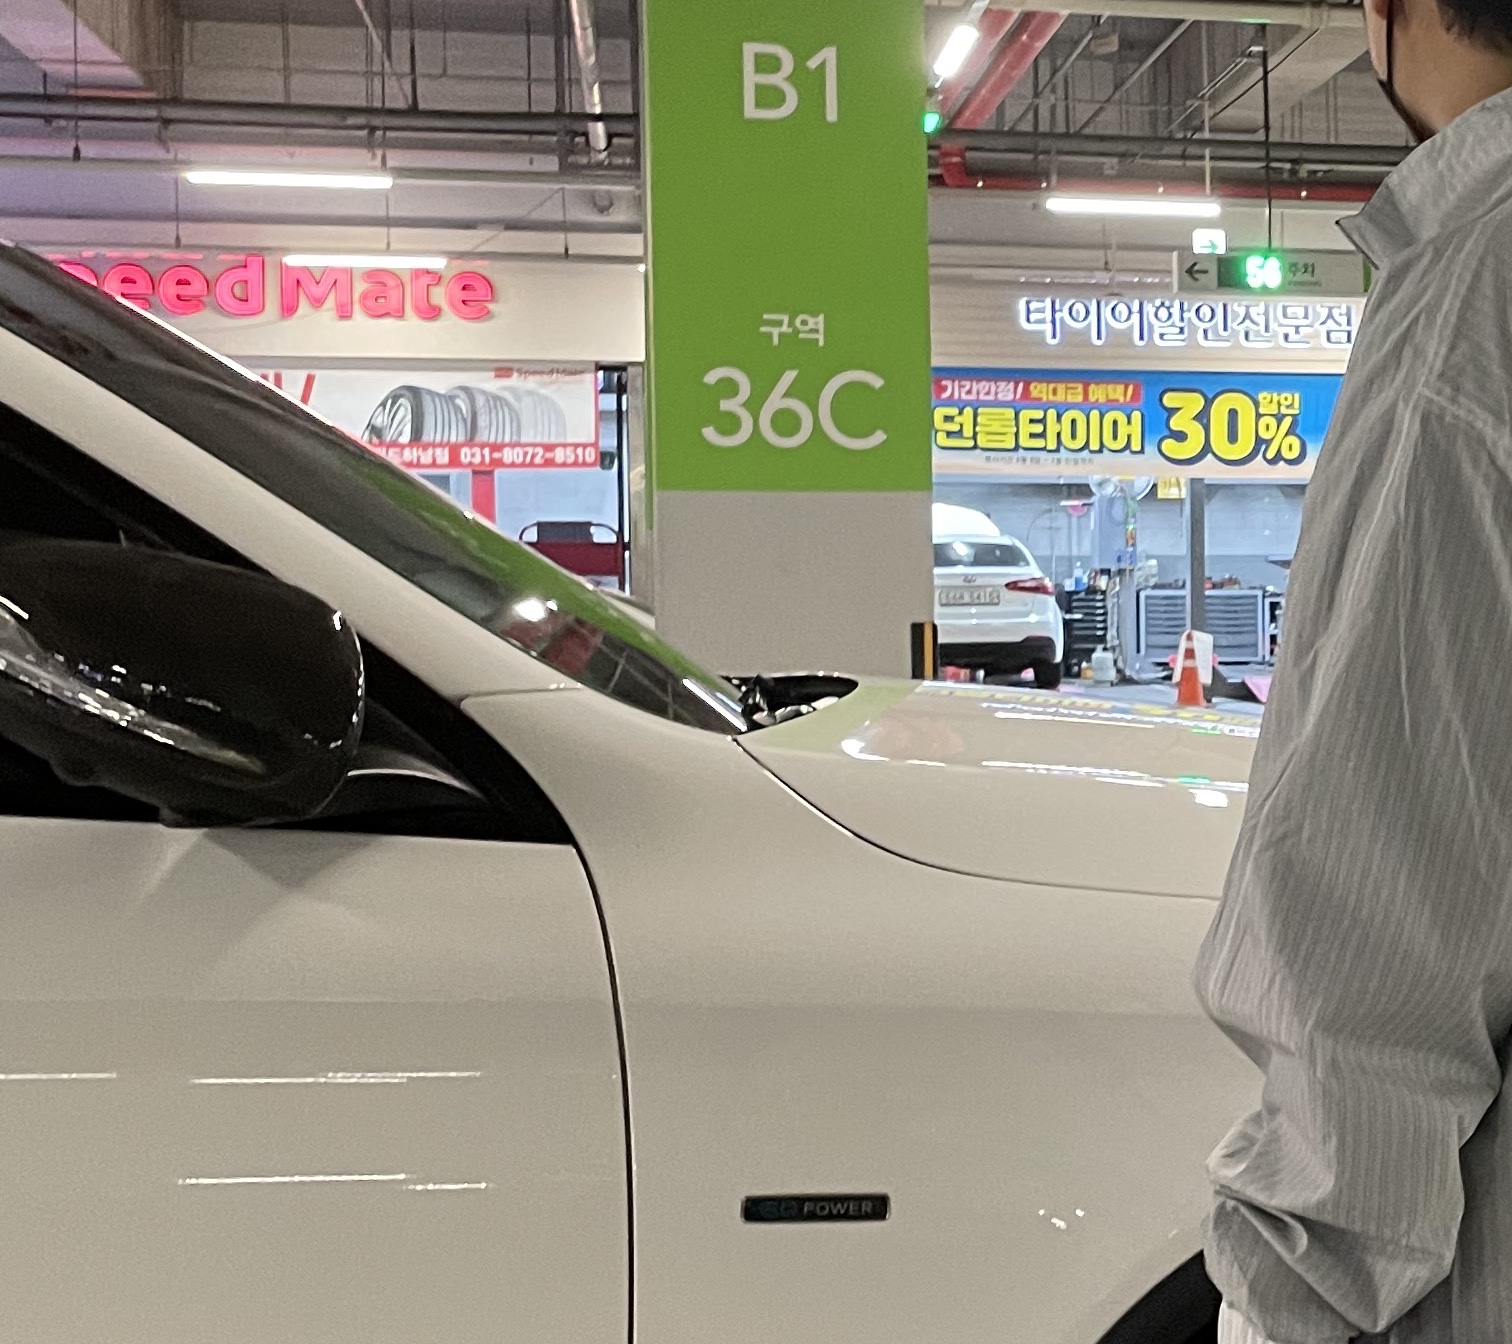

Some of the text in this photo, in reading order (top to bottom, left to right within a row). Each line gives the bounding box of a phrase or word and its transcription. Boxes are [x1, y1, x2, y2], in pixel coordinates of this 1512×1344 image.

[742, 41, 839, 123] B1
[759, 313, 825, 347] 구역
[1019, 296, 1355, 348] 타이어할인전문점
[701, 366, 888, 450] 36C
[1257, 391, 1301, 415] 할인
[933, 405, 1143, 453] 던롭타이어
[803, 1200, 873, 1216] POWER
